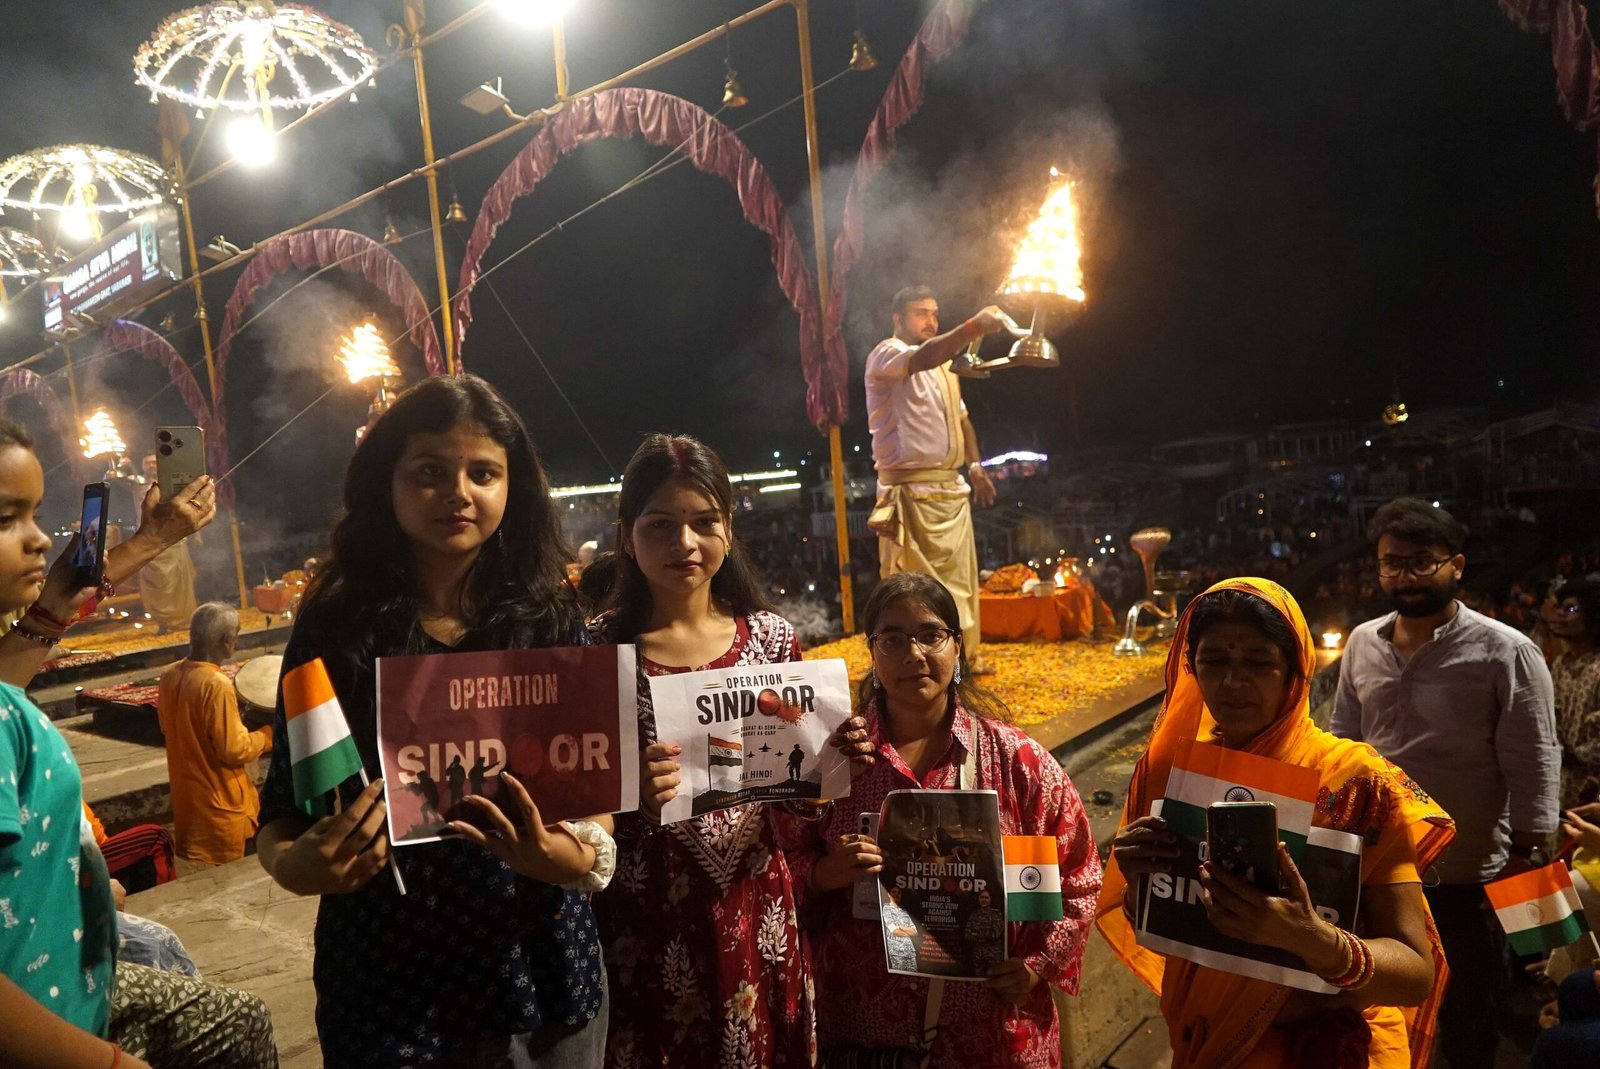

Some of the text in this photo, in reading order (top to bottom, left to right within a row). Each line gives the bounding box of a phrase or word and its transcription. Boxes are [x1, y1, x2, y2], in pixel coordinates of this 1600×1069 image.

[90, 250, 111, 278] SEVA
[726, 673, 783, 689] OPERATION
[449, 674, 559, 711] OPERATION
[739, 769, 773, 782] JAI HIND!
[907, 861, 975, 877] OPERATION
[929, 895, 951, 903] INDIA'S
[928, 908, 952, 916] AGAINST
